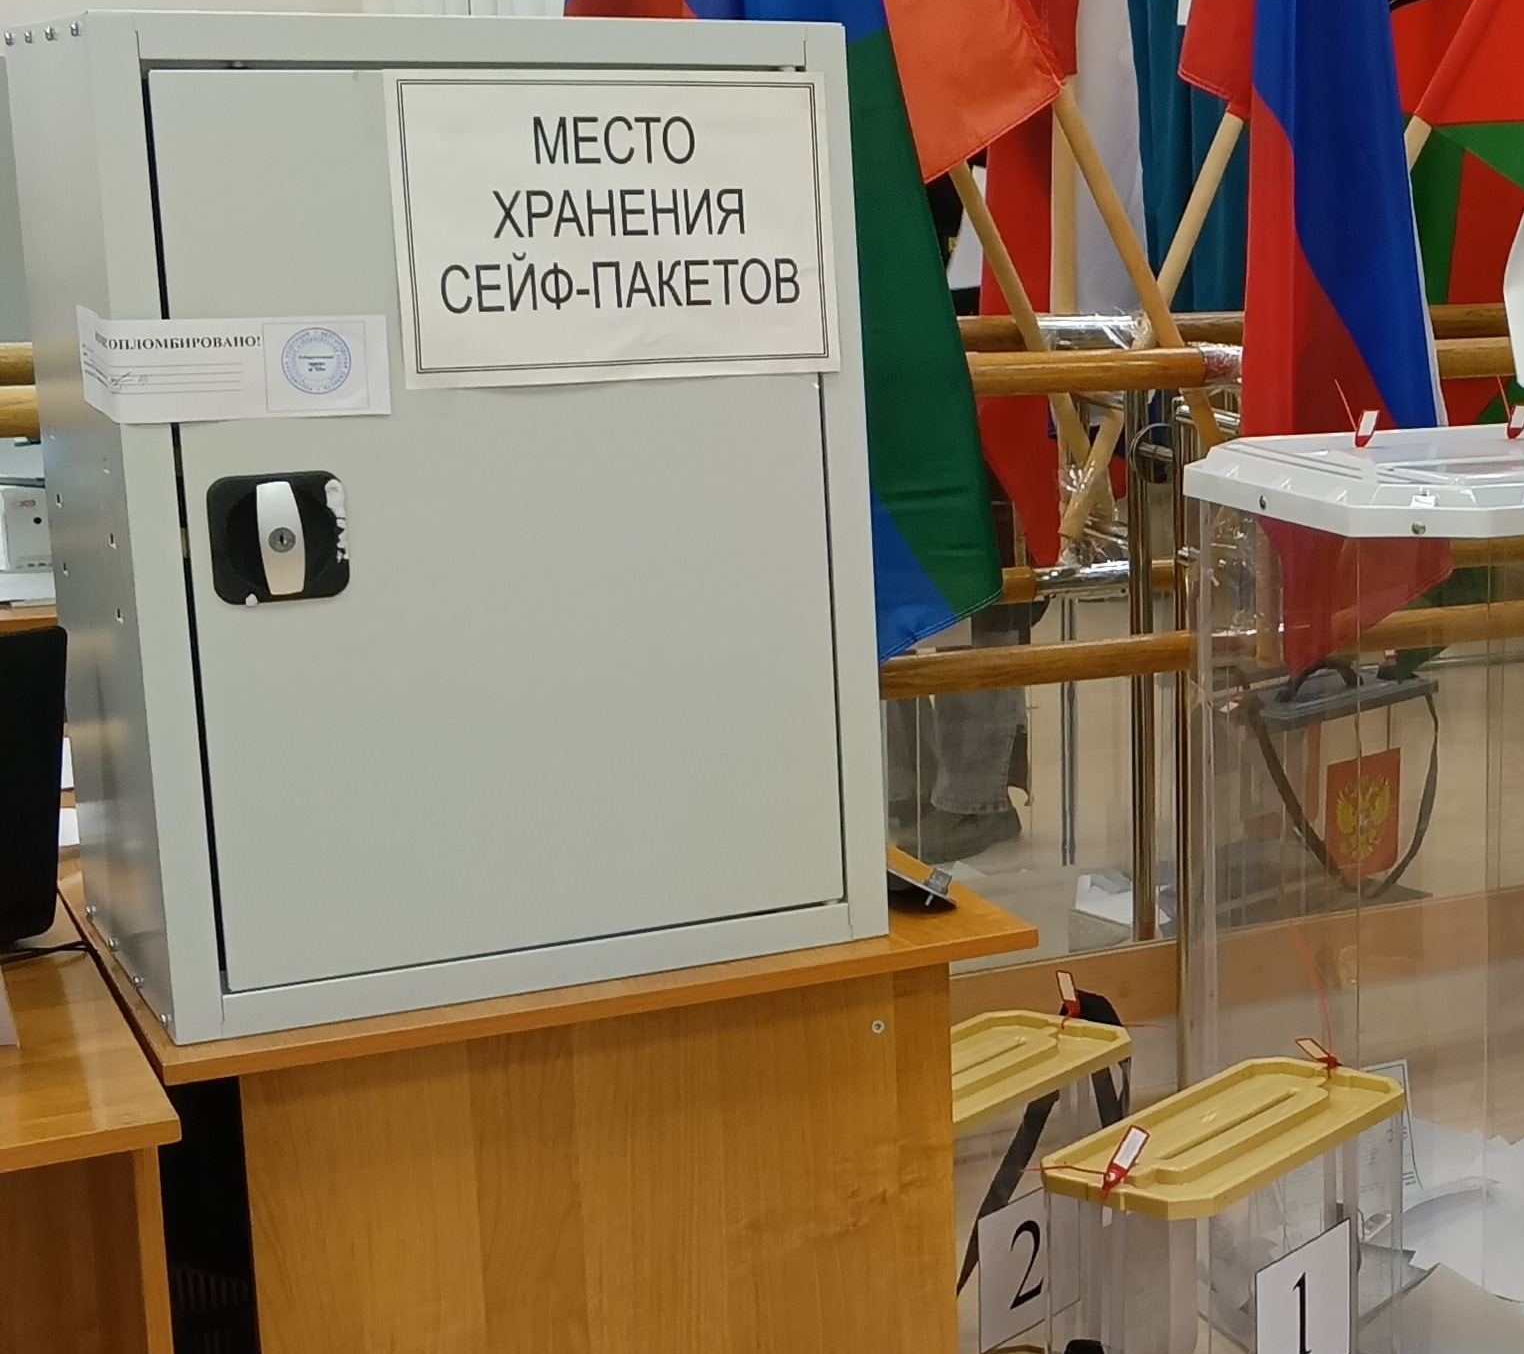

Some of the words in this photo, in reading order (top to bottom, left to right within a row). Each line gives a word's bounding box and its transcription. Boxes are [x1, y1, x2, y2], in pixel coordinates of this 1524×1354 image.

[533, 116, 696, 165] МЕСТО
[492, 188, 746, 239] ХРАНЕНИЯ
[440, 252, 801, 314] СЕЙФ-ПАКЕТОВ
[1009, 1219, 1045, 1311] 2
